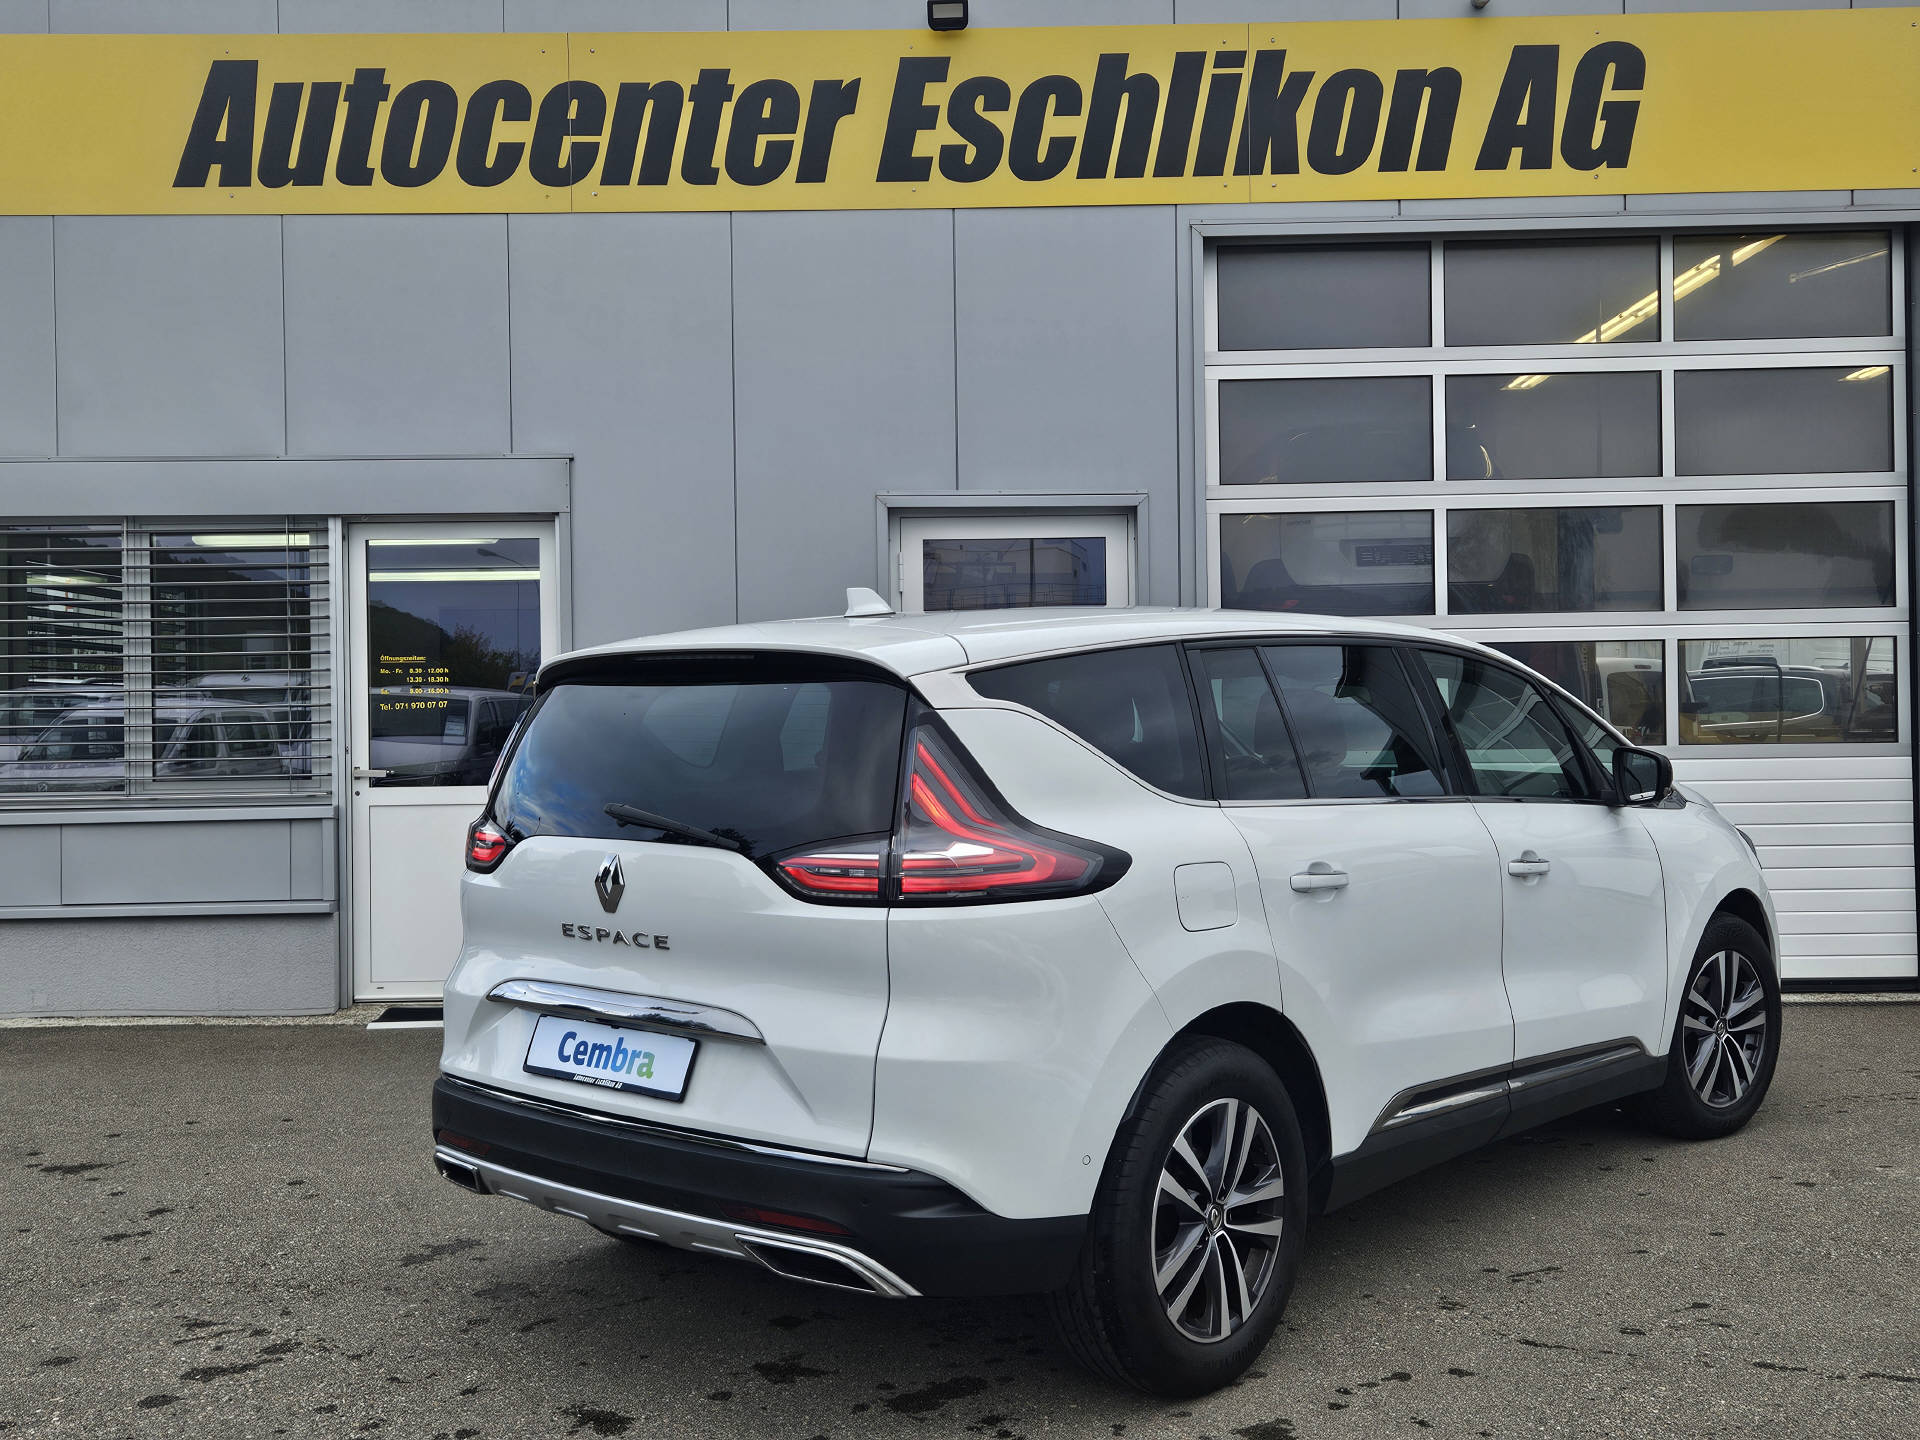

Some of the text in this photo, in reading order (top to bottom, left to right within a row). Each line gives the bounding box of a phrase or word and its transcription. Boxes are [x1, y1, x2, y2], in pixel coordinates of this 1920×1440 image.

[172, 40, 1647, 189] Autocenter Eschlikon AG
[380, 703, 394, 711] Tel.
[395, 702, 408, 710] 071
[427, 701, 436, 709] 07
[438, 700, 448, 708] 07
[561, 922, 670, 950] ESPACE
[557, 1031, 656, 1079] Cembra
